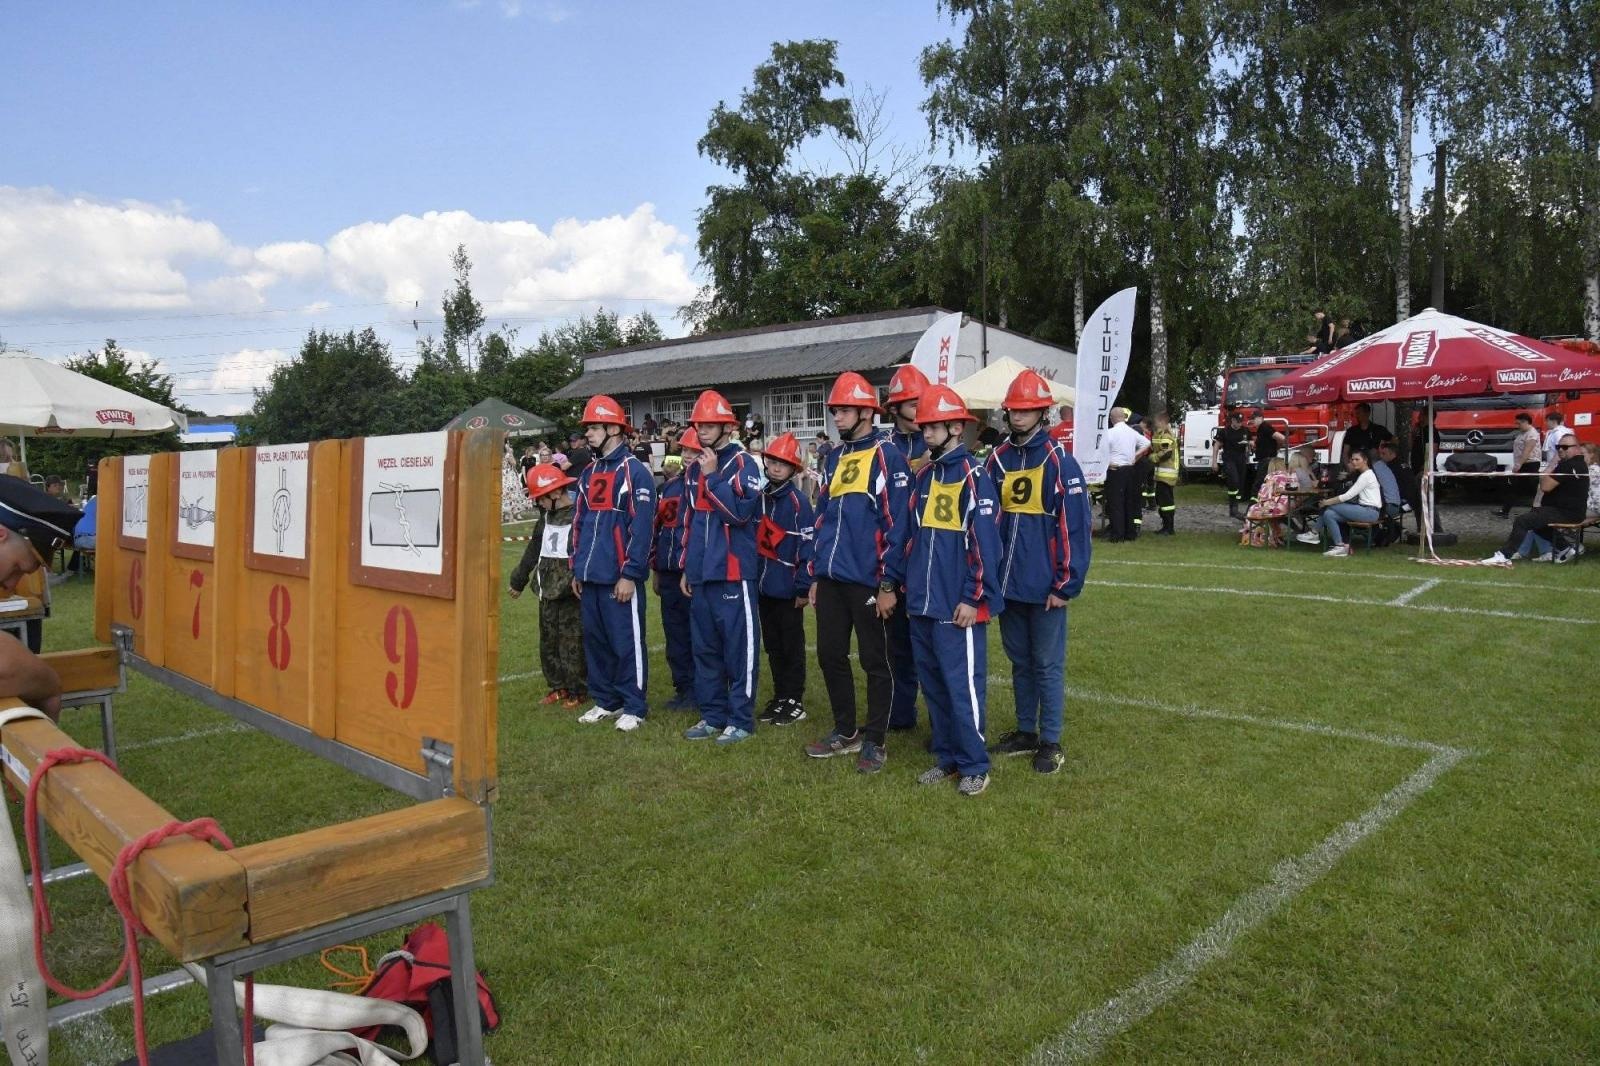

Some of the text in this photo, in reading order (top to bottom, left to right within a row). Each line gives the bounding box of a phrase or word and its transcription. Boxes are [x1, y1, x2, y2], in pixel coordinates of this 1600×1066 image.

[1404, 331, 1432, 366] WARKA
[1350, 380, 1392, 391] WARKA
[1424, 372, 1469, 389] Classic
[1500, 371, 1534, 382] WARKA
[1558, 367, 1592, 382] Classic
[1270, 388, 1291, 398] WARKA
[400, 455, 434, 468] CIESIELSKI
[593, 479, 608, 504] 2
[1011, 476, 1032, 505] 9
[934, 494, 953, 522] 8
[548, 531, 559, 553] 1
[128, 558, 143, 621] 6
[190, 569, 204, 641] 7
[267, 584, 291, 671] 8
[383, 604, 419, 709] 9
